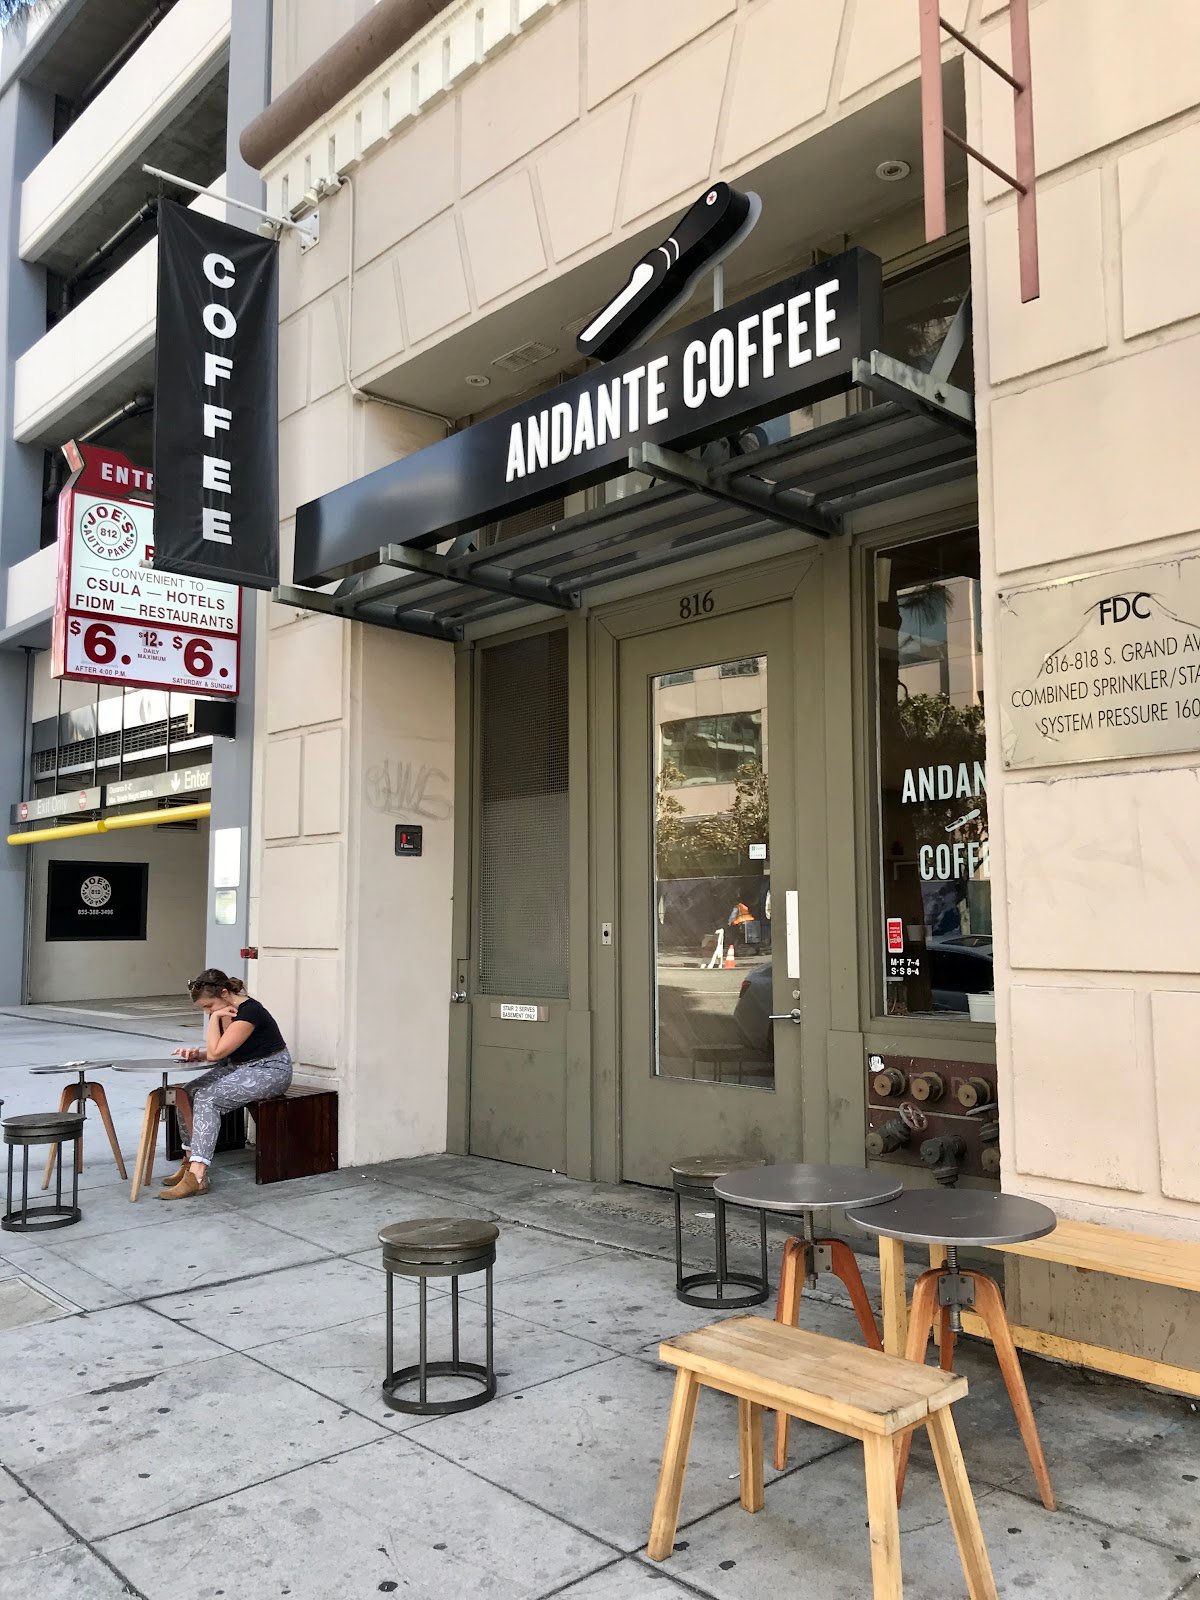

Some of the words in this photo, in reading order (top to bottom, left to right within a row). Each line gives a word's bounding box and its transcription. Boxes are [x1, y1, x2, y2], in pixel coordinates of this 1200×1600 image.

[505, 355, 669, 483] ANDANTE
[683, 278, 841, 409] COFFEE
[202, 252, 237, 545] COFFEE
[87, 506, 134, 534] JOE'S
[100, 527, 118, 539] 812
[83, 529, 105, 554] AUTO
[107, 536, 134, 557] PARKS
[86, 577, 141, 597] CSULA
[167, 590, 225, 610] HOTELS
[112, 567, 185, 588] CONVENIENT
[189, 580, 204, 592] TO
[75, 594, 114, 611] FIDM
[139, 604, 234, 630] RESTAURANTS
[680, 590, 714, 619] 816
[1100, 592, 1151, 626] FDC
[75, 665, 97, 674] AFTER
[137, 653, 166, 662] MAXIMUM
[1045, 650, 1099, 675] 816-818
[1104, 647, 1116, 665] S.
[1121, 637, 1178, 662] GRAND
[172, 677, 202, 686] SATURDAY
[210, 682, 233, 690] SUNDAY
[1011, 681, 1088, 708] COMBINED
[1041, 712, 1093, 735] SYSTEM
[1098, 702, 1168, 728] PRESSURE
[1175, 698, 1200, 719] 160
[184, 769, 210, 790] Enter
[901, 761, 987, 804] ANDAN
[37, 799, 50, 815] Exit
[51, 795, 68, 814] Only
[84, 877, 110, 890] JOE'S
